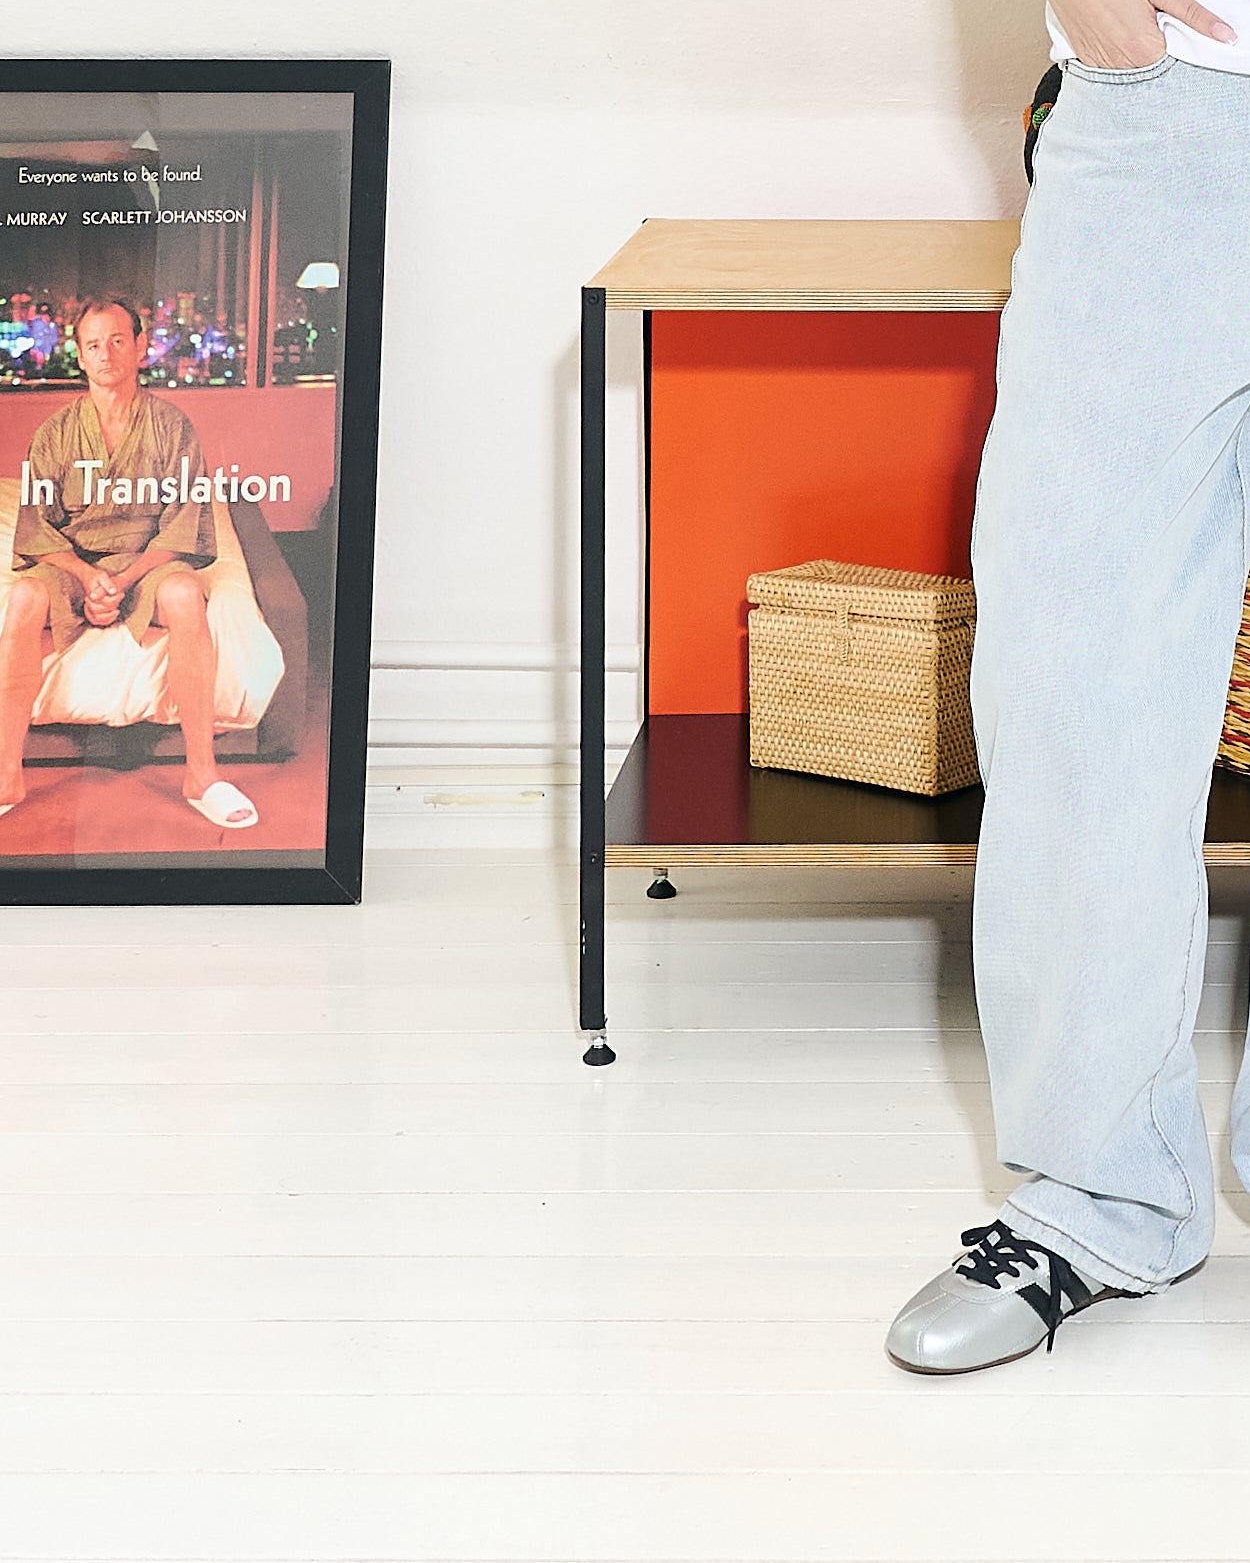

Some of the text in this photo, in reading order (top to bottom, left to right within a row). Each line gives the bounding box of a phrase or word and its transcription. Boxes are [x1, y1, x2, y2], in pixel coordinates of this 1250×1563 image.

[18, 164, 202, 187] Everyone wants to be found.
[6, 208, 247, 226] MURRAY SCARLETT JOHANSSON
[20, 455, 291, 506] In Translation
